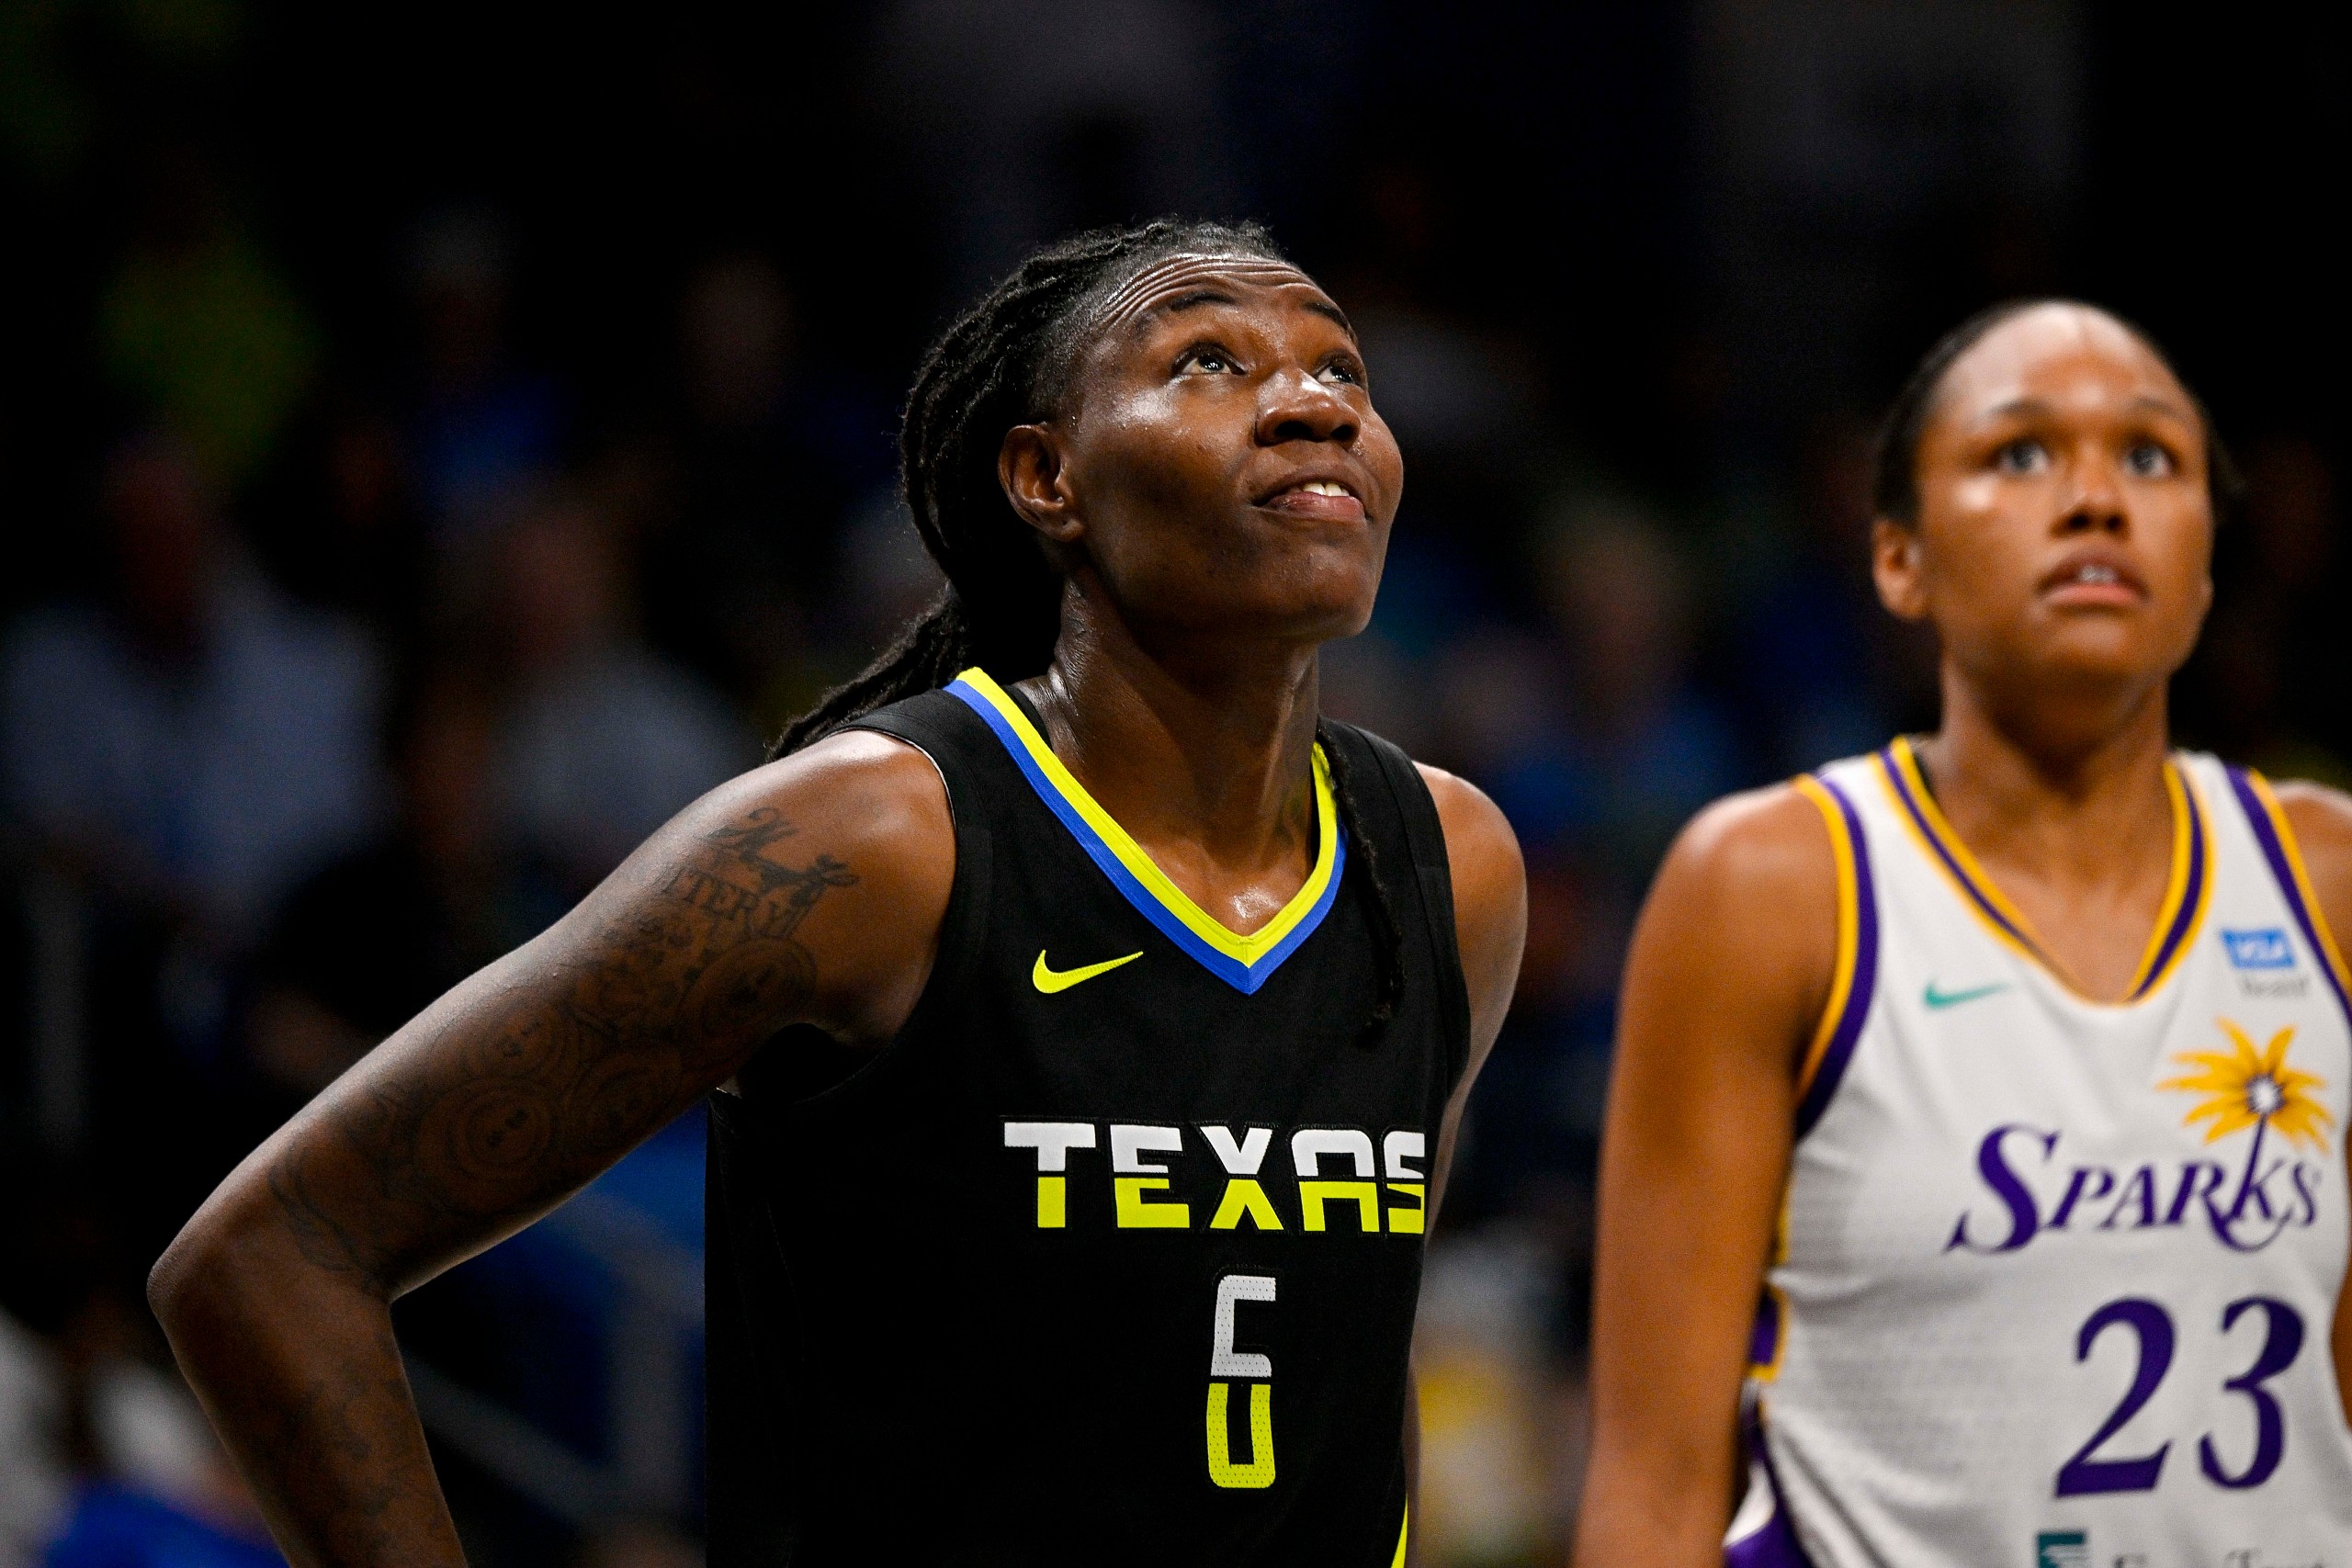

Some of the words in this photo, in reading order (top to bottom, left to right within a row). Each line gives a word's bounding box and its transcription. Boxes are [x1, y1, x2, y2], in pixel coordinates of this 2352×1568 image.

[1004, 1122, 1425, 1235] TEXAS
[1205, 1274, 1276, 1489] 6
[2052, 1294, 2308, 1499] 23
